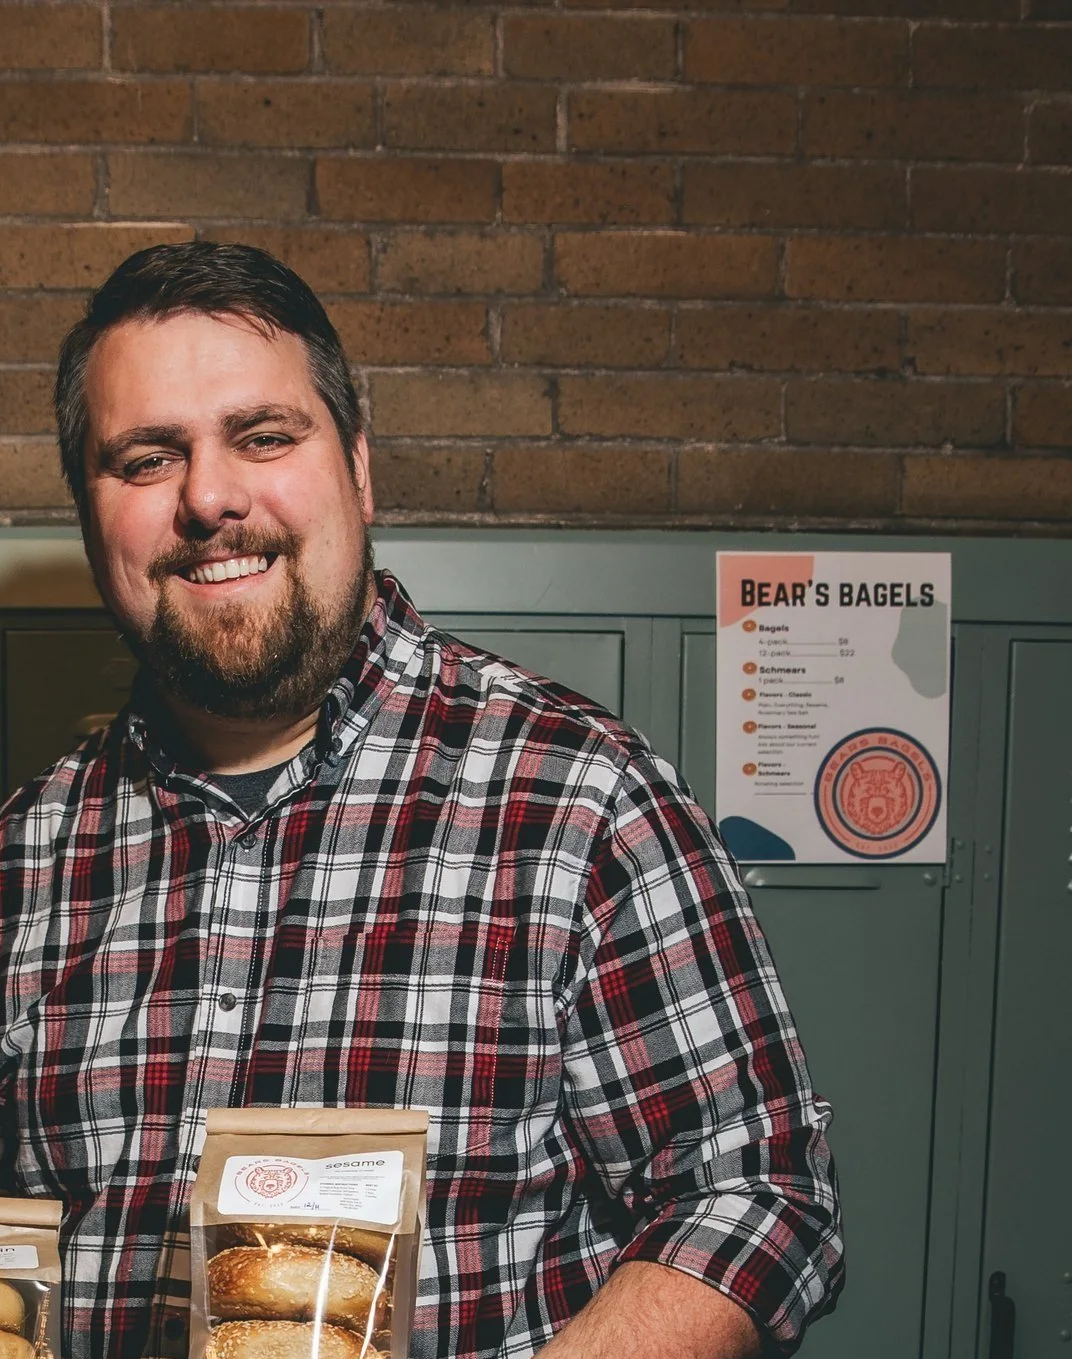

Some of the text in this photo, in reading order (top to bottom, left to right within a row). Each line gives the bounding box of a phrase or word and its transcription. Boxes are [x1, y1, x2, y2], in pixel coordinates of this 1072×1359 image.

[740, 579, 935, 608] BEAR'S BAGELS
[758, 624, 789, 634] Bagels
[759, 665, 806, 674] Schmears
[325, 1159, 386, 1170] sesame
